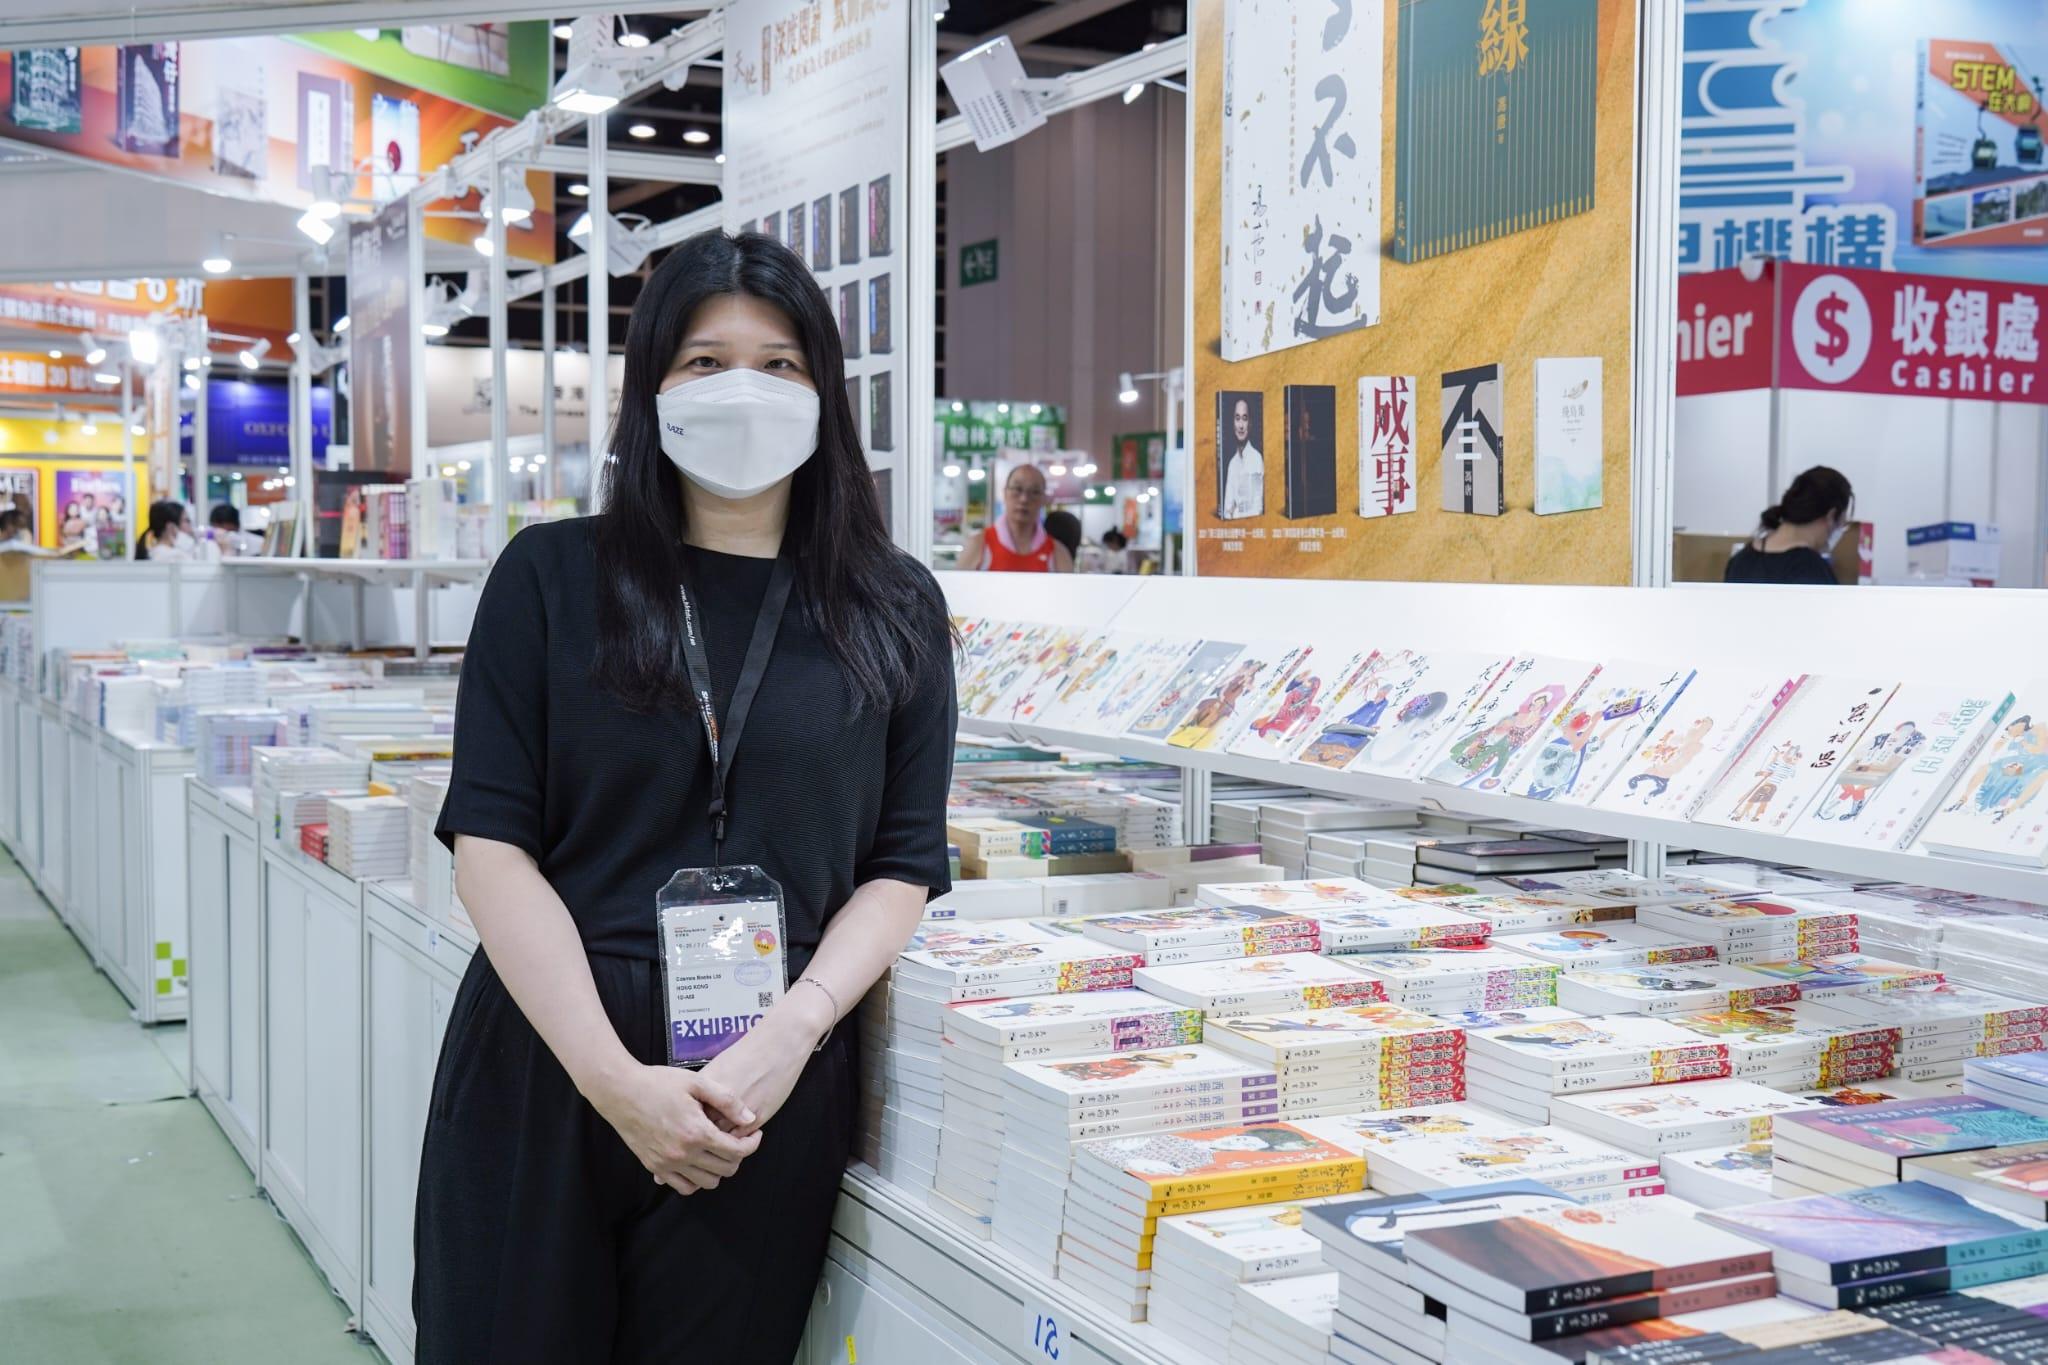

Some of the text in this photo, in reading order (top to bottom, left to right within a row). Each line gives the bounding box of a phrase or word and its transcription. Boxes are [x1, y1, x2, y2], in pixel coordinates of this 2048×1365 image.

[1953, 61, 2016, 91] STEM
[1892, 284, 2040, 363] 收銀處
[1891, 359, 2035, 395] Cashier
